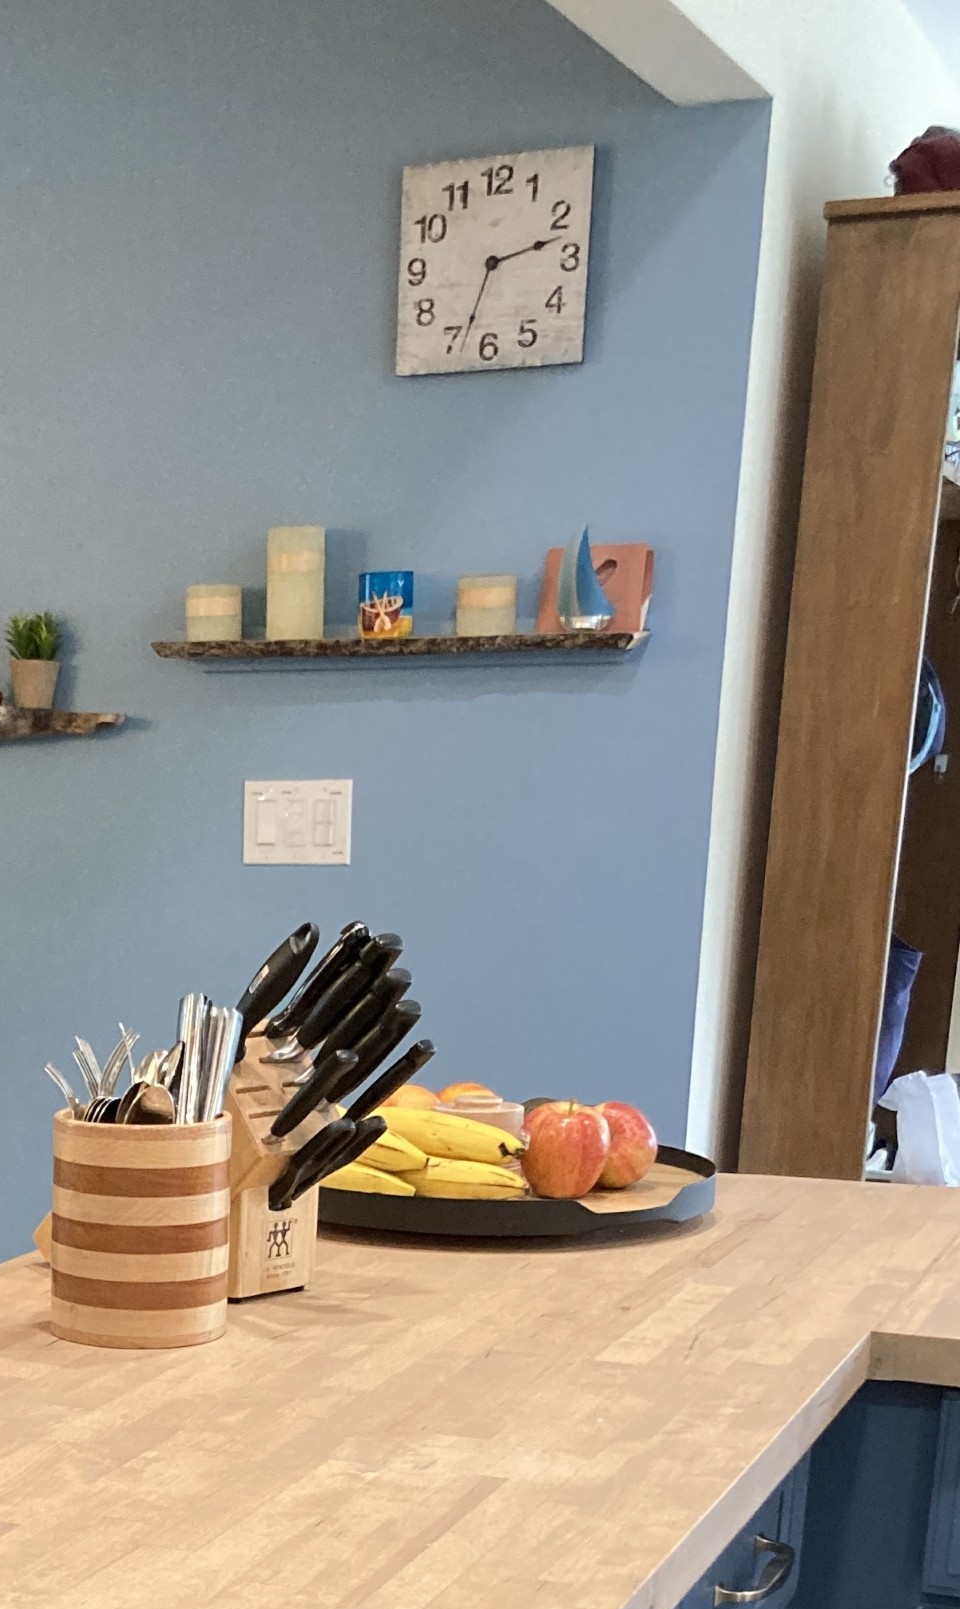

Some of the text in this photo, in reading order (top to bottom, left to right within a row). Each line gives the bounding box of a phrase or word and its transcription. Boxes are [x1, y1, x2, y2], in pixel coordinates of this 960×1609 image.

[480, 164, 514, 196] 12
[526, 173, 539, 202] 1
[442, 180, 469, 211] 11
[414, 213, 447, 244] 10
[550, 200, 571, 230] 2
[560, 243, 580, 272] 3
[407, 258, 427, 287] 9
[415, 298, 435, 326] 8
[545, 285, 565, 314] 4
[443, 325, 463, 355] 7
[478, 332, 499, 361] 6
[516, 319, 538, 348] 5
